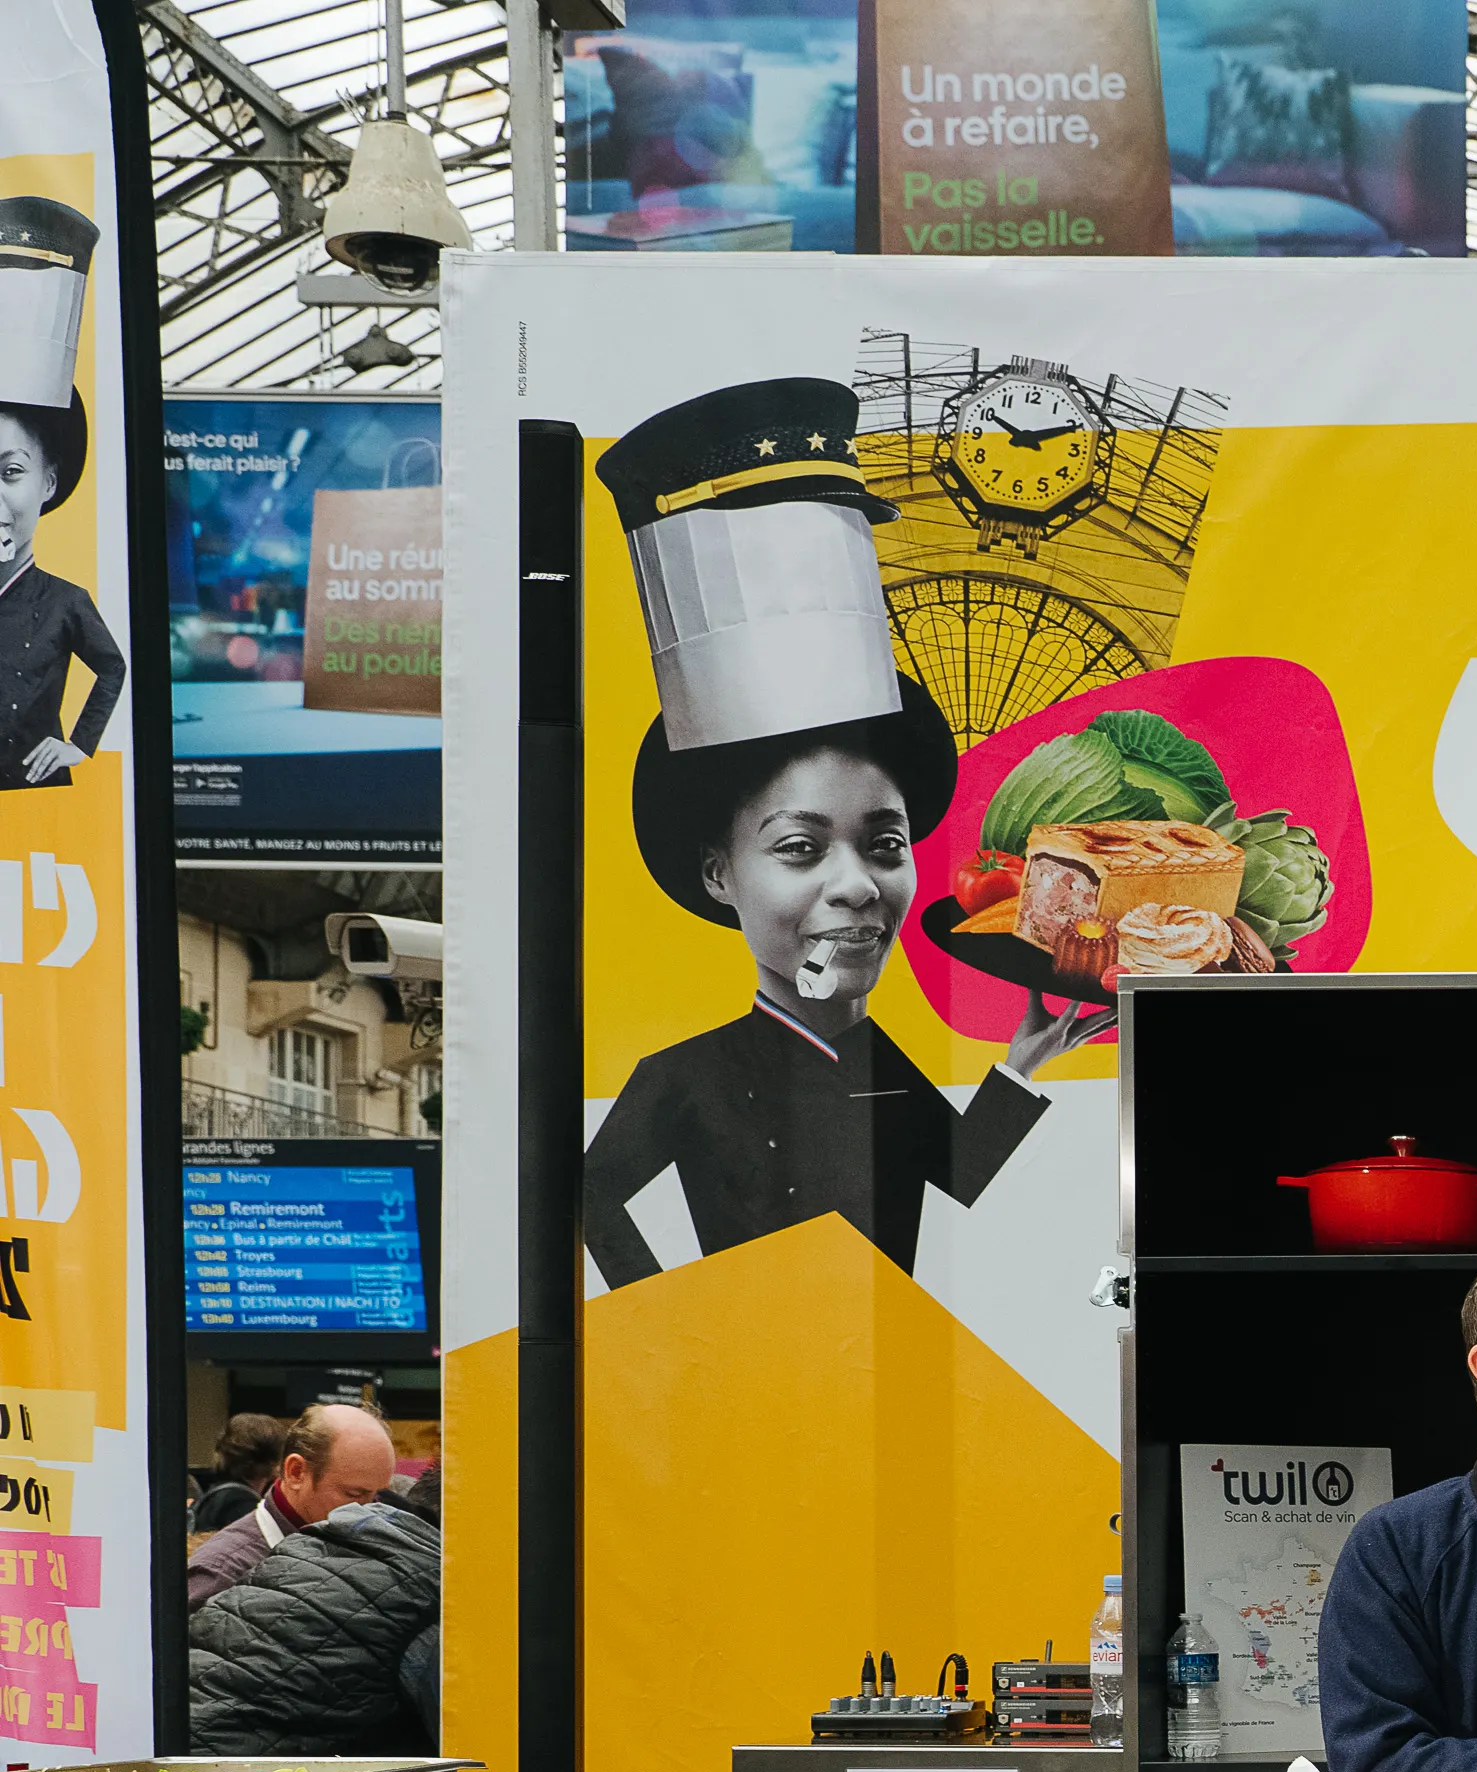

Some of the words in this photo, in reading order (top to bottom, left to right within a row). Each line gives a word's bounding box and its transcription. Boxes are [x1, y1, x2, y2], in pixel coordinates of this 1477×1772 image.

[901, 64, 962, 104] Un
[972, 63, 1127, 103] monde
[902, 107, 934, 148] à
[945, 105, 1099, 149] refaire,
[904, 170, 987, 210] Pas
[997, 170, 1039, 206] la
[904, 210, 1105, 252] vaisselle.
[518, 377, 528, 398] RCS
[229, 431, 259, 451] qui
[187, 455, 233, 472] ferait
[235, 455, 288, 475] plaisir
[290, 456, 300, 473] ?
[327, 542, 385, 571] Une
[523, 572, 570, 582] BOSE
[326, 579, 360, 601] au
[324, 617, 379, 644] Des
[322, 653, 356, 674] au
[175, 838, 212, 849] VOTRE
[255, 838, 304, 850] MANGEZ
[324, 839, 361, 851] MOINS
[372, 840, 411, 851] FRUITS
[233, 1140, 276, 1158] lignes
[226, 1170, 271, 1186] Nancy
[230, 1201, 326, 1216] Remiremont
[267, 1217, 344, 1230] Remiremont
[233, 1232, 257, 1246] Bus
[268, 1233, 303, 1247] partir
[304, 1234, 321, 1246] de
[235, 1248, 276, 1263] Troyes
[236, 1264, 303, 1281] Strasbourg
[237, 1280, 277, 1293] Reims
[240, 1296, 326, 1309] DESTINATION
[335, 1297, 373, 1310] NACH
[241, 1313, 318, 1327] Luxembourg
[1224, 1510, 1258, 1523] Scan
[1261, 1510, 1271, 1523] &
[1275, 1510, 1312, 1523] achat
[1316, 1510, 1333, 1523] de
[1336, 1510, 1356, 1523] vin
